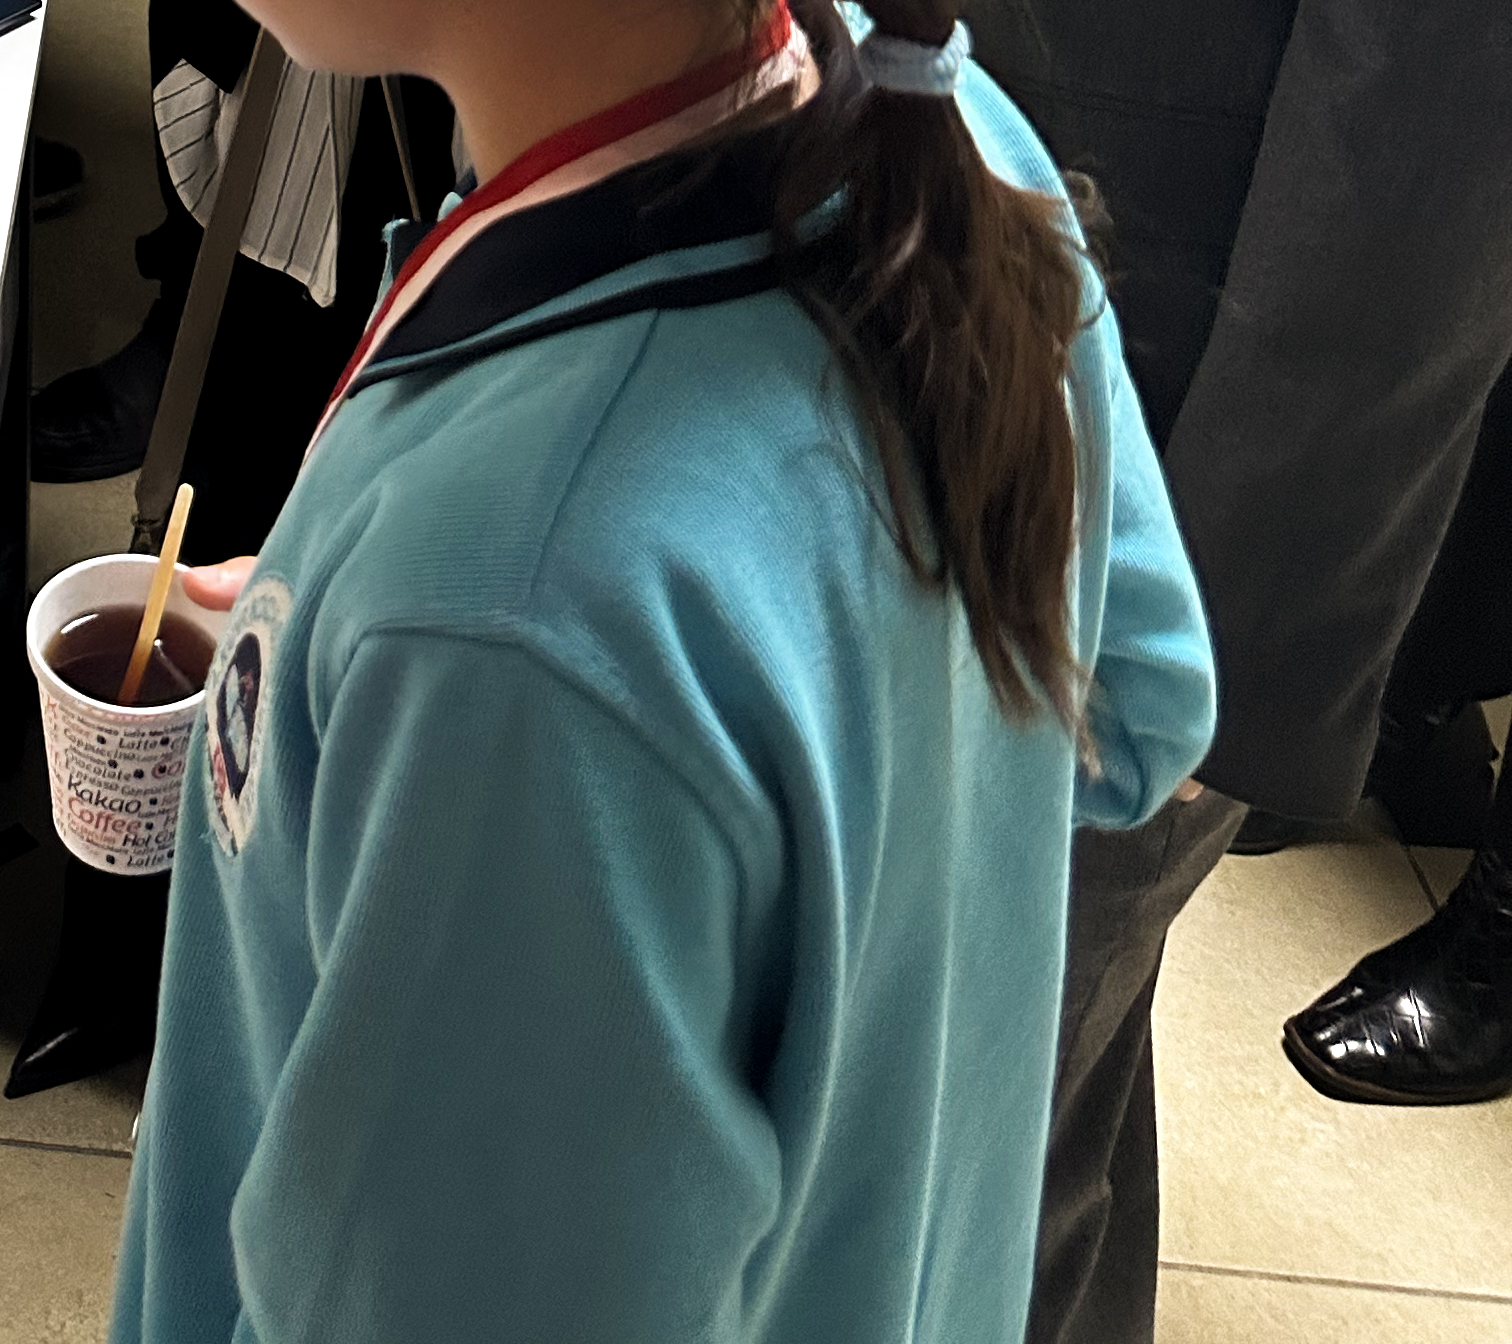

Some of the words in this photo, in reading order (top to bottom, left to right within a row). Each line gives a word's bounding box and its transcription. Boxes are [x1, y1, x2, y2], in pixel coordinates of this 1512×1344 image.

[119, 736, 158, 751] Latte
[64, 748, 132, 780] Chocolate
[67, 773, 142, 814] Kakao
[68, 796, 141, 833] Coffee
